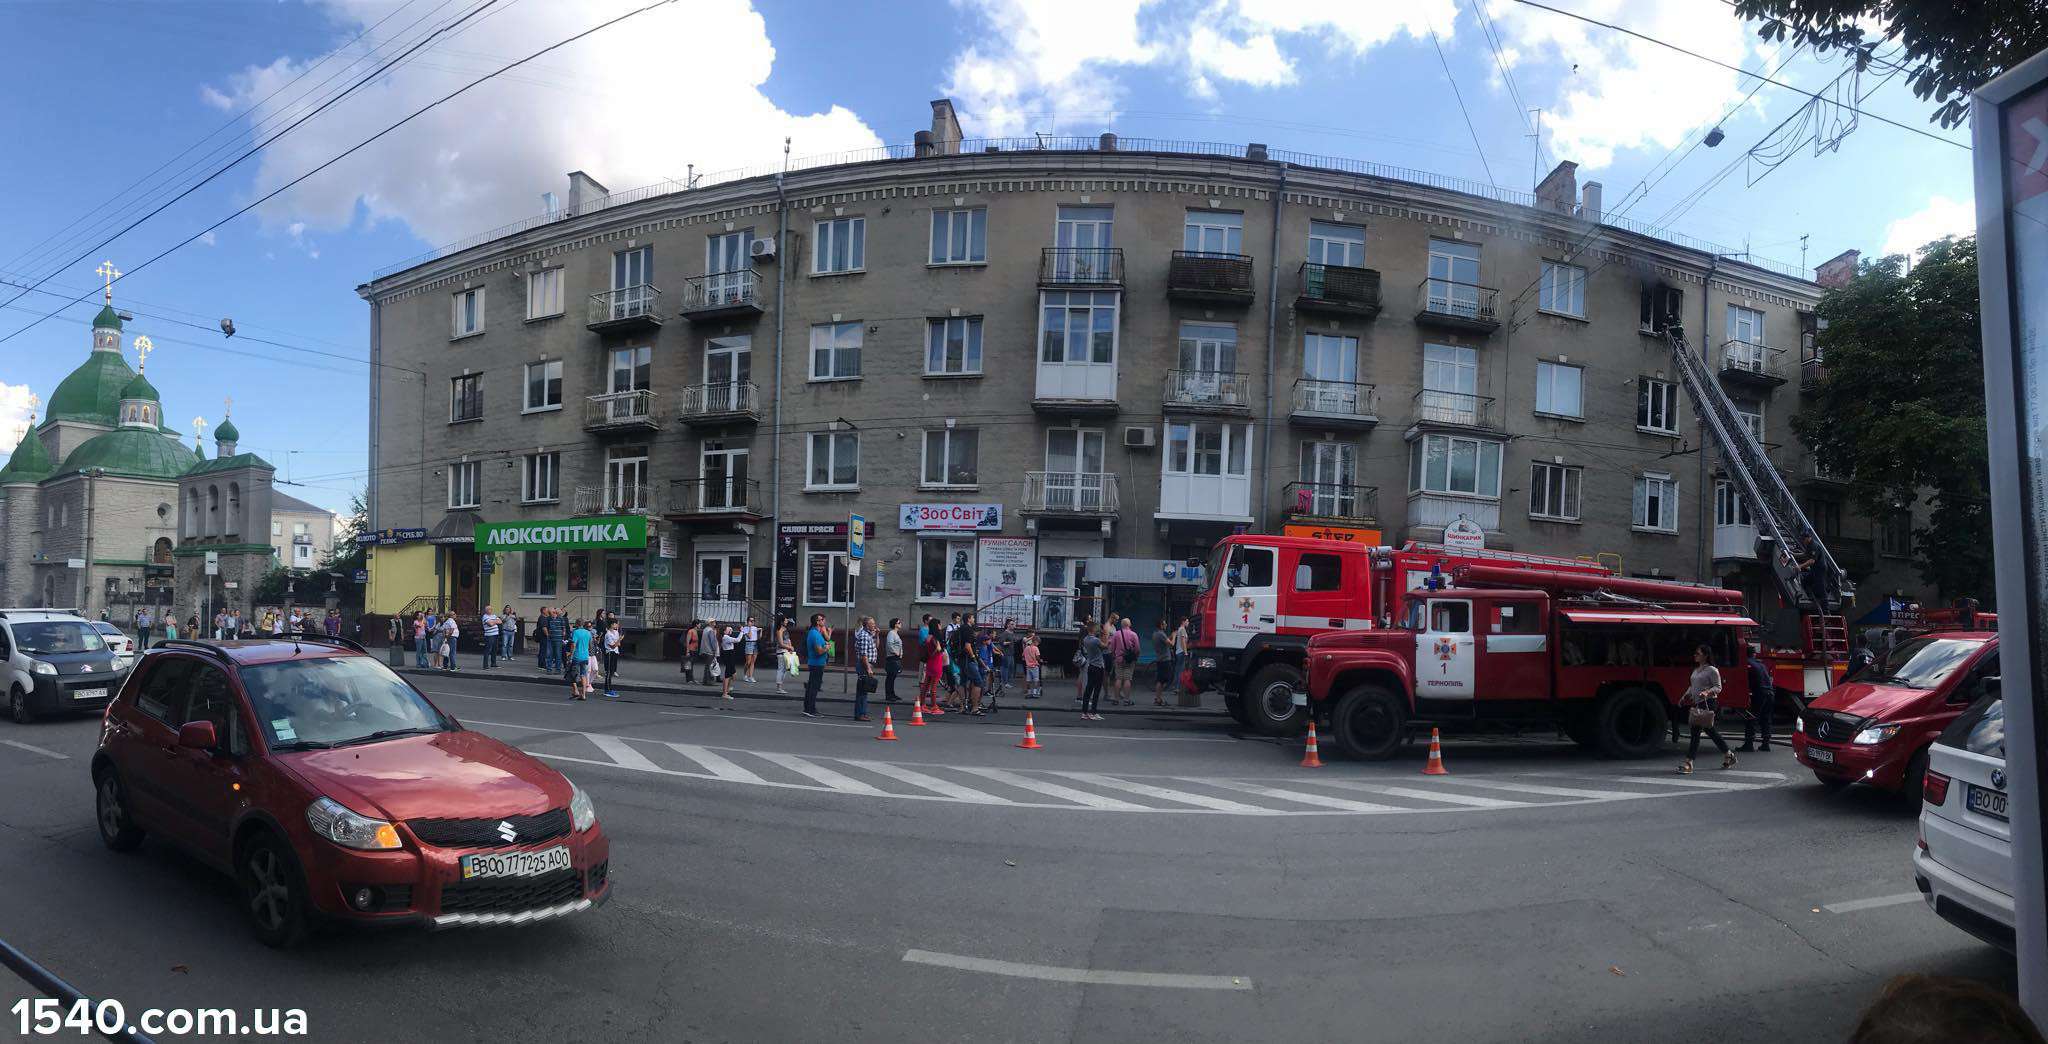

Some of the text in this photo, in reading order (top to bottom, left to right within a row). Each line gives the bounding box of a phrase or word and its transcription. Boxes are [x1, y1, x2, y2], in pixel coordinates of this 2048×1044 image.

[920, 506, 984, 520] Зоо Світ
[487, 523, 629, 545] ЛЮКСОПТИКА
[1242, 614, 1248, 623] 1
[1441, 662, 1447, 675] 1
[1993, 796, 2008, 813] 00
